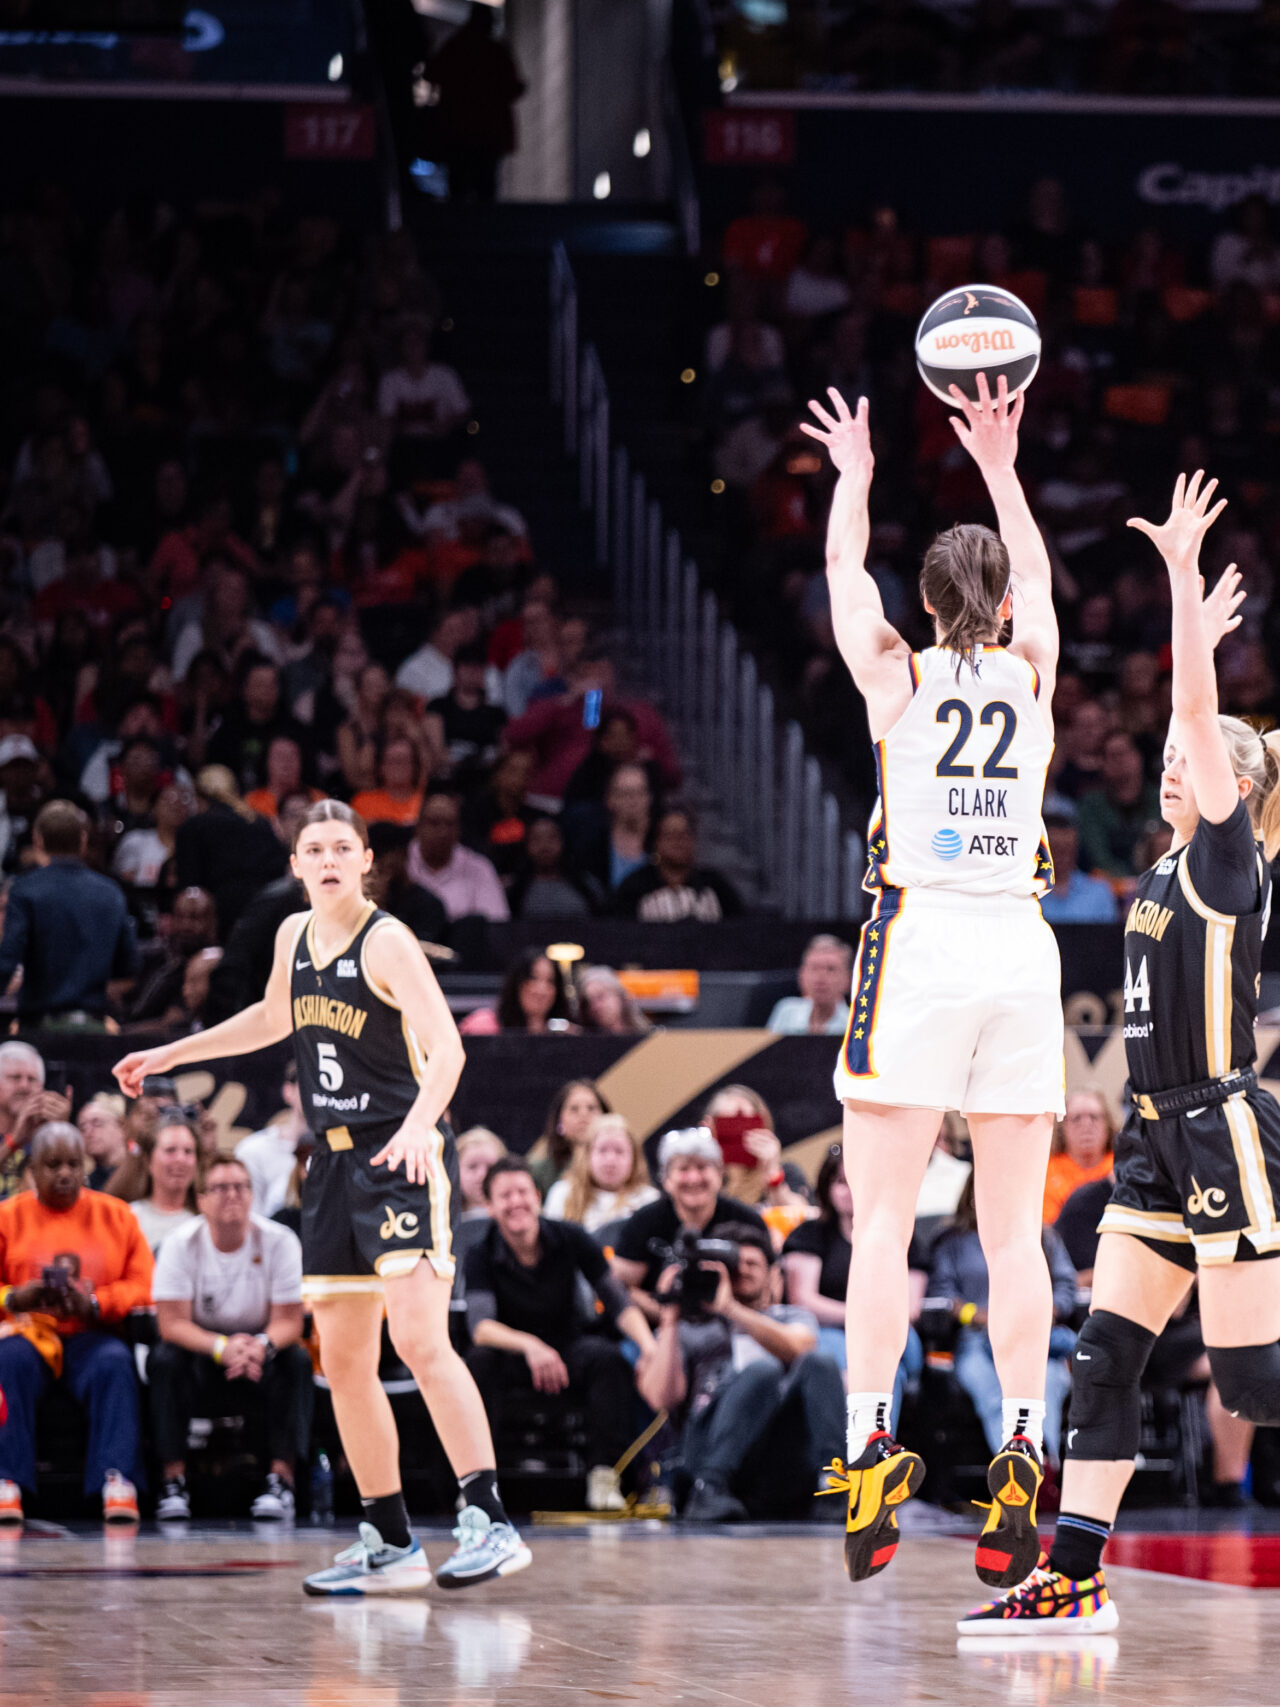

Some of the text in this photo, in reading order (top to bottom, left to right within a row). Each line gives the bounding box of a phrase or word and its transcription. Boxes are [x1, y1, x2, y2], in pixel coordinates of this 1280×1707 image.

[934, 328, 1016, 354] Wilson
[935, 698, 1019, 780] 22
[948, 787, 1008, 818] CLARK
[968, 834, 1019, 857] AT&T
[317, 1042, 344, 1092] 5
